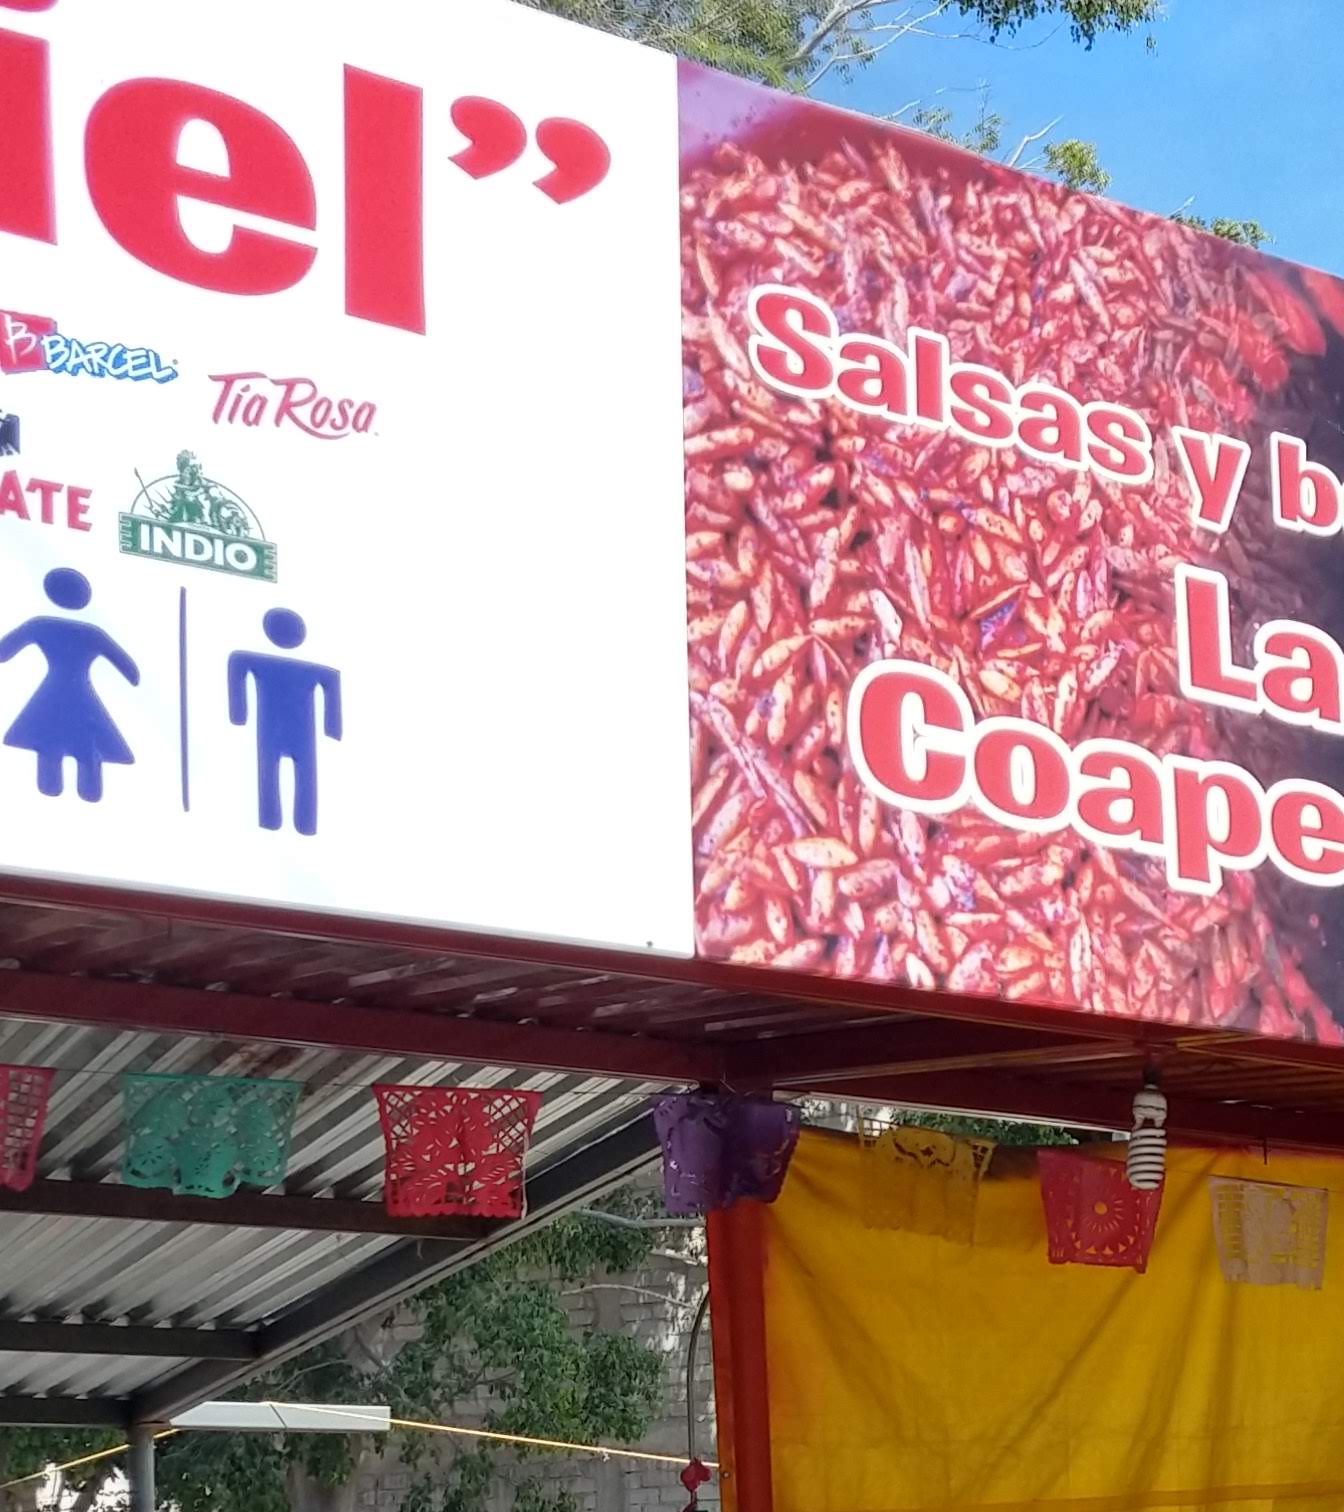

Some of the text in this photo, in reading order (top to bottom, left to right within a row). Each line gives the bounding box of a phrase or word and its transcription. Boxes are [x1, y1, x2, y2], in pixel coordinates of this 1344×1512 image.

[41, 333, 178, 384] BARCEL
[208, 372, 378, 440] Tía Rosa
[746, 283, 1153, 484] Salsas
[1174, 425, 1249, 532] y
[140, 524, 257, 570] INDIO
